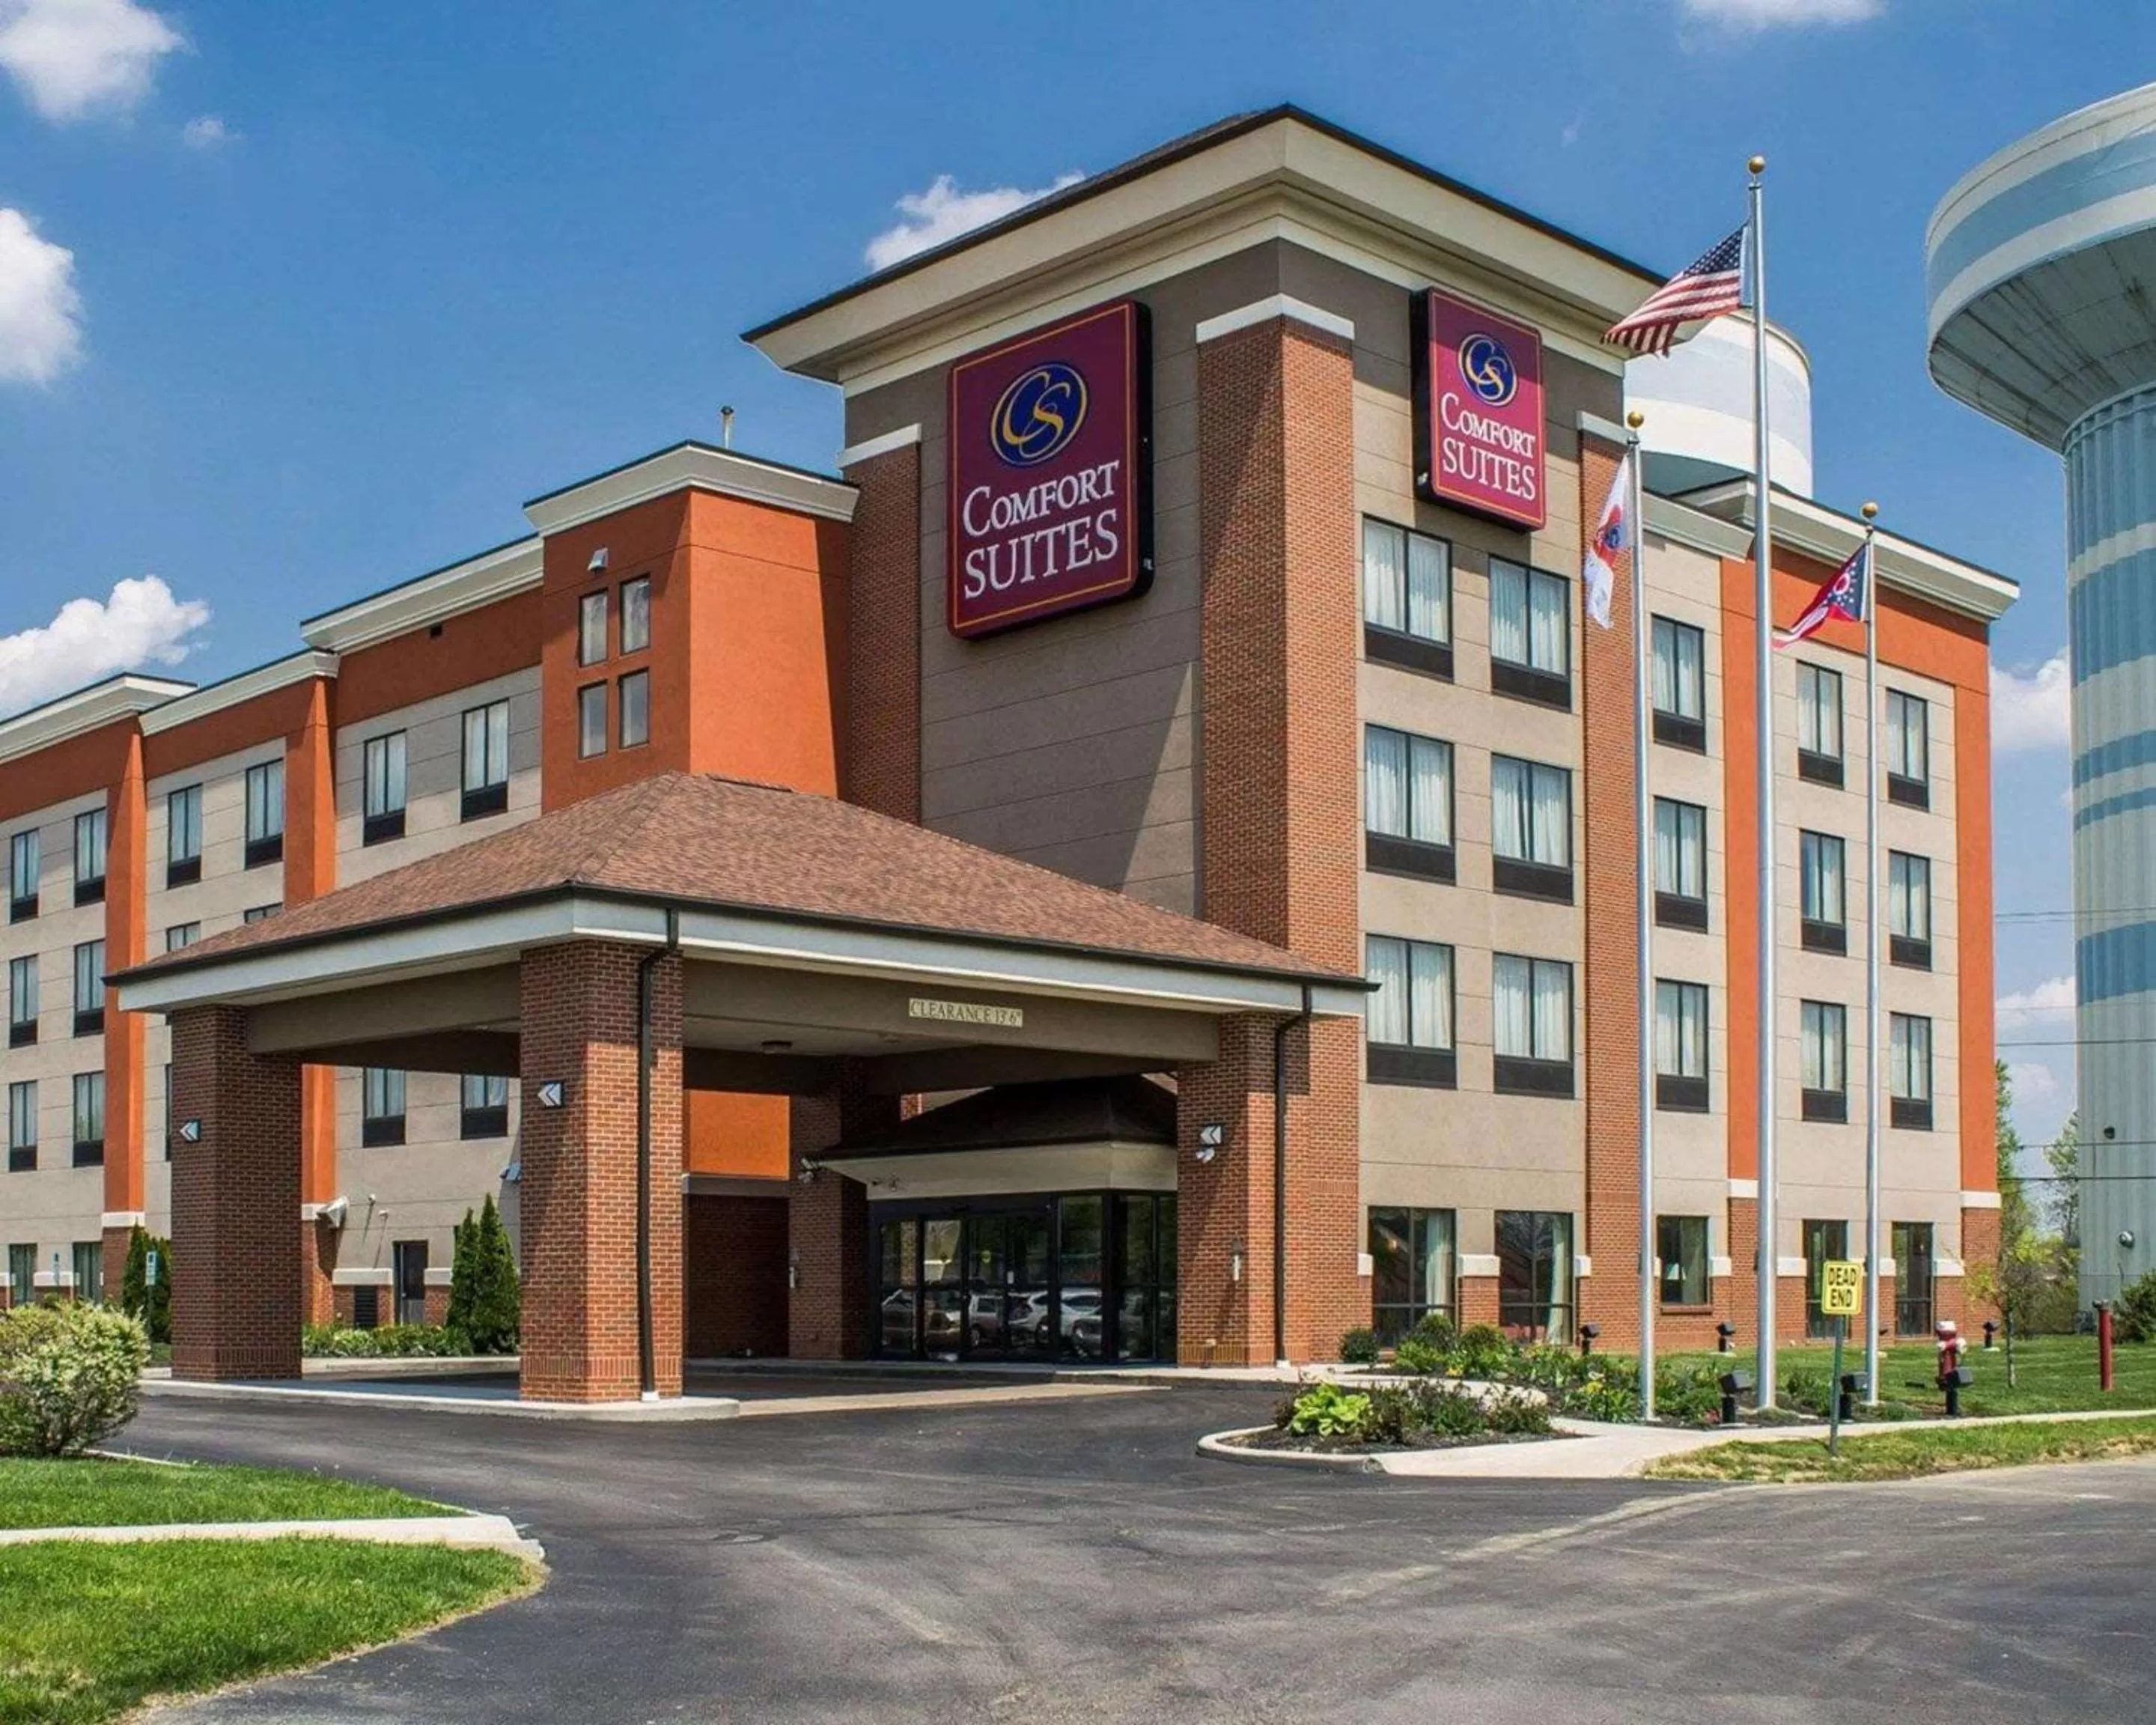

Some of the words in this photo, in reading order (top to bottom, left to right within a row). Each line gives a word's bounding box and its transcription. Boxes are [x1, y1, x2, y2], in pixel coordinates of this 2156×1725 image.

[1441, 392, 1535, 459] COMFORT
[963, 460, 1120, 538] COMFORT
[1443, 436, 1536, 501] SUITES
[964, 508, 1118, 600] SUITES
[910, 1000, 991, 1023] CLEARANCE
[1828, 1267, 1857, 1286] DEAD
[1830, 1289, 1853, 1307] END
